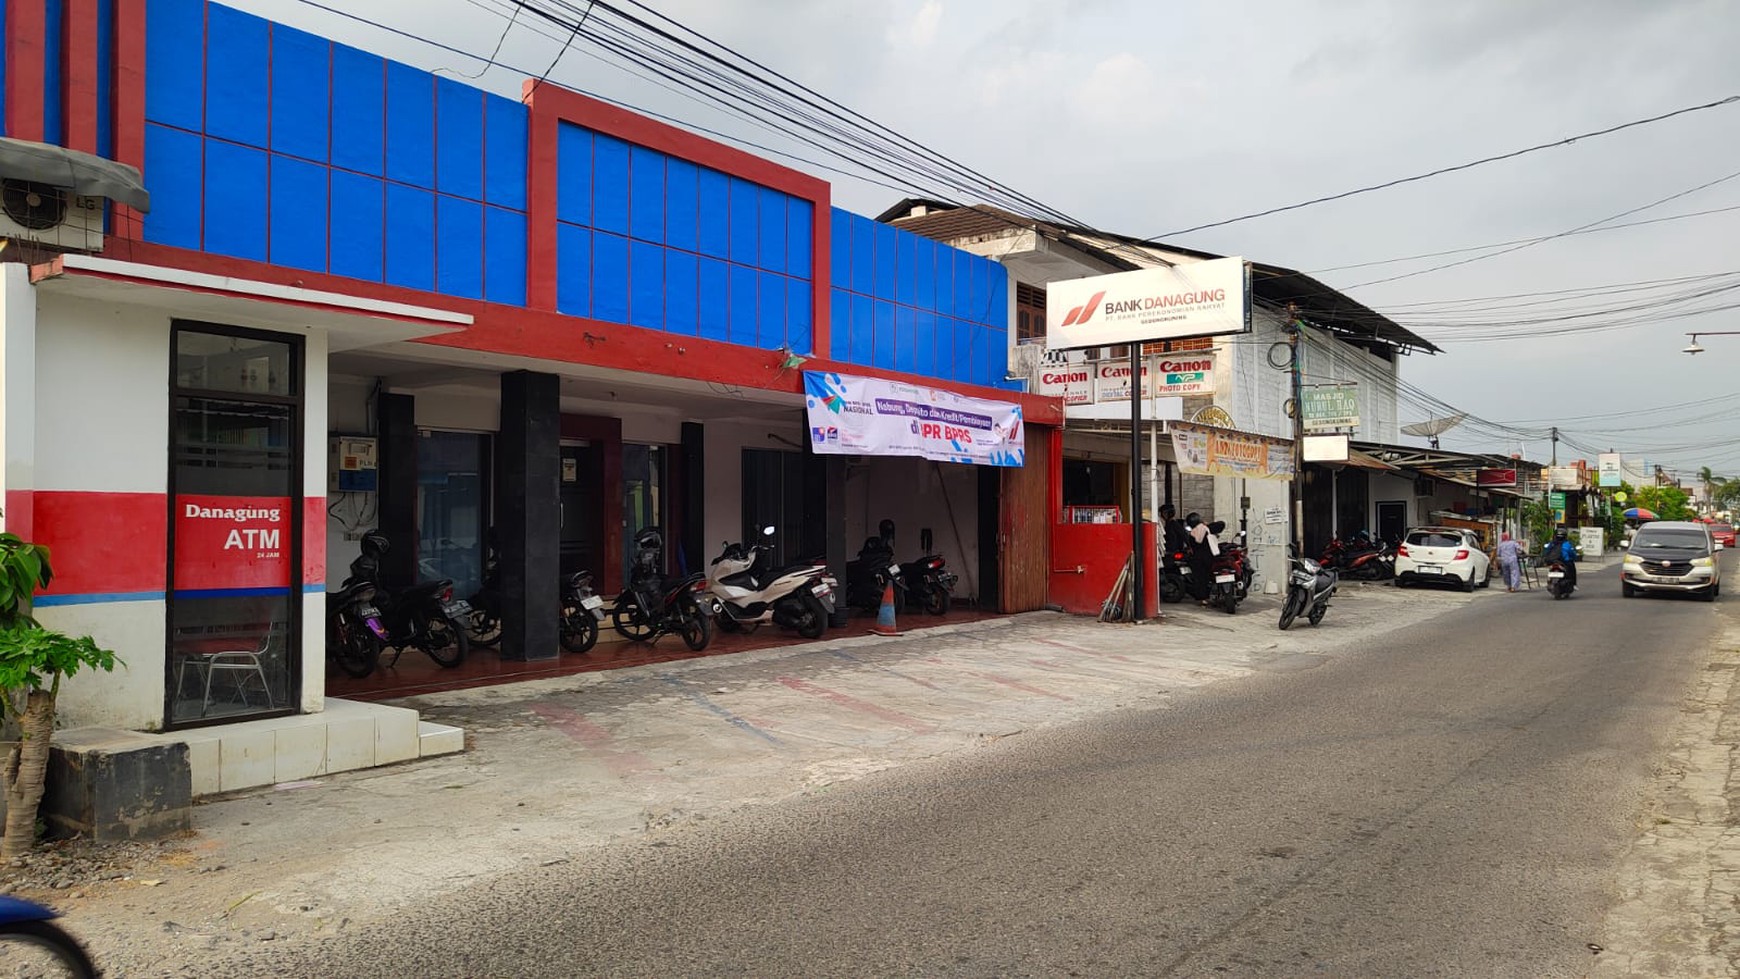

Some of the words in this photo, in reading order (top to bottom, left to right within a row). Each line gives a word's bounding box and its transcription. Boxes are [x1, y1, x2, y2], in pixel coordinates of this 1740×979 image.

[76, 197, 95, 210] LG
[1105, 299, 1142, 314] BANK
[1144, 289, 1225, 310] DANAGUNG
[1160, 360, 1212, 373] Canon
[1042, 372, 1088, 384] Canon
[1183, 383, 1200, 391] COPY
[1313, 392, 1344, 400] MASJID
[843, 405, 873, 416] NASIONAL
[911, 420, 920, 435] di
[944, 425, 972, 444] BPRS
[185, 504, 281, 522] Danagung
[223, 529, 280, 550] ATM
